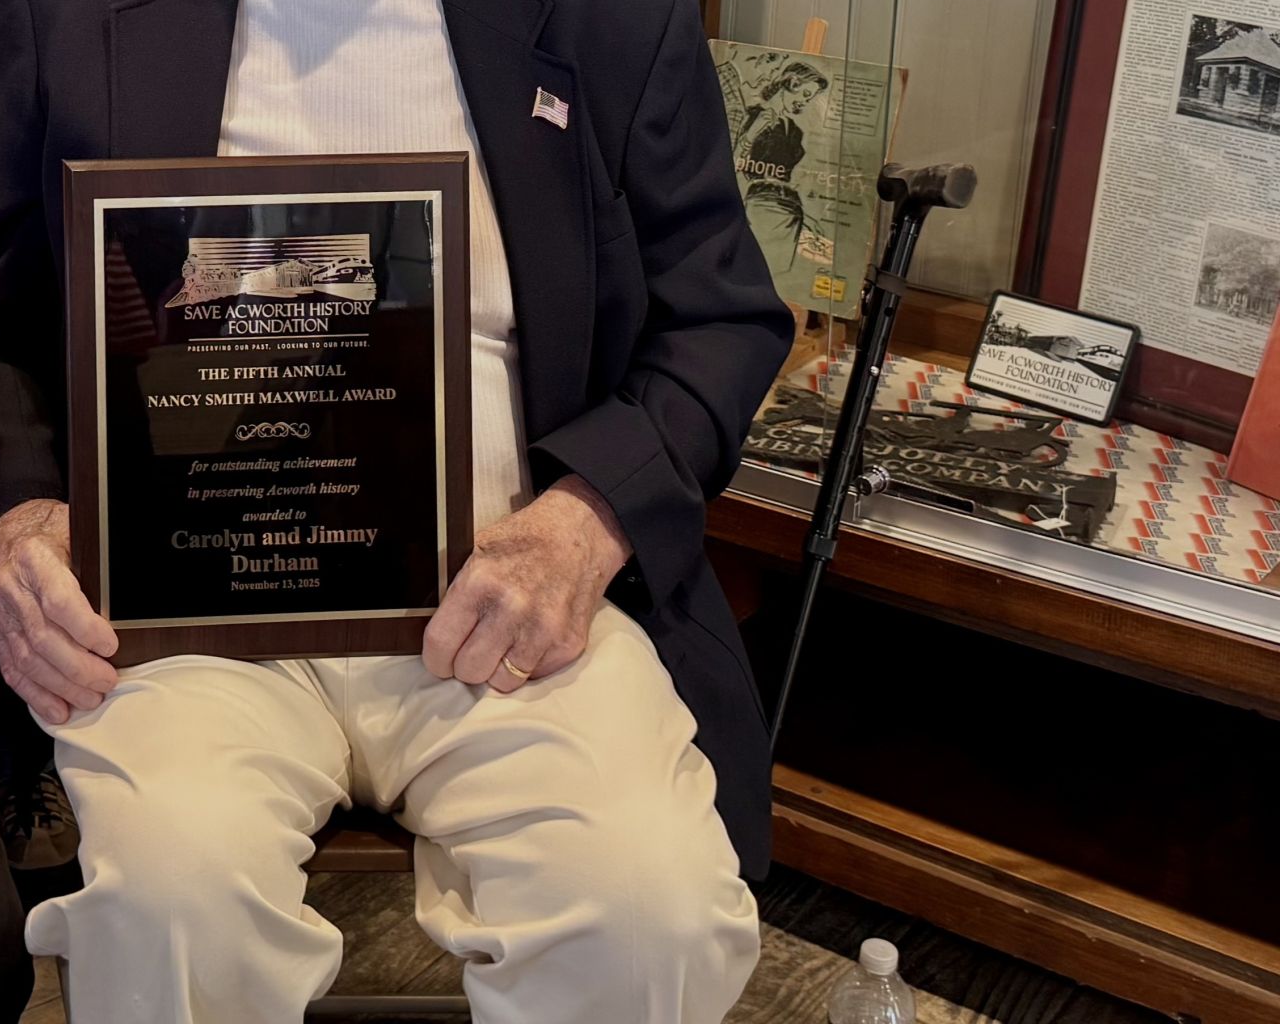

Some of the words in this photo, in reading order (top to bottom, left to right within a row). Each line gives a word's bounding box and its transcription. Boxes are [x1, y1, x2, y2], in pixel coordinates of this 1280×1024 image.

[184, 305, 221, 320] SAVE
[225, 303, 305, 319] ACWORTH
[310, 301, 372, 316] HISTORY
[228, 318, 328, 334] FOUNDATION
[198, 368, 229, 380] THE
[234, 367, 278, 379] FIFTH
[282, 365, 346, 378] ANNUAL
[979, 345, 1006, 361] SAVE
[1007, 354, 1066, 378] ACWORTH
[1067, 370, 1114, 392] HISTORY
[1005, 365, 1079, 394] FOUNDATION
[148, 394, 201, 407] NANCY
[205, 393, 254, 405] SMITH
[259, 390, 338, 404] MAXWELL
[342, 388, 396, 401] AWARD
[188, 460, 209, 475] for
[211, 458, 280, 472] outstanding
[283, 457, 357, 468] achievement
[880, 459, 1075, 495] COMPANY
[187, 487, 199, 498] in
[201, 485, 264, 501] preserving
[266, 483, 316, 496] Acworth
[319, 482, 360, 495] history
[243, 509, 293, 521] awarded
[295, 510, 306, 519] to
[172, 529, 255, 552] Carolyn
[262, 527, 300, 545] and
[307, 526, 378, 546] Jimmy
[231, 553, 319, 573] Durham
[231, 580, 279, 591] November
[298, 578, 320, 588] 2025
